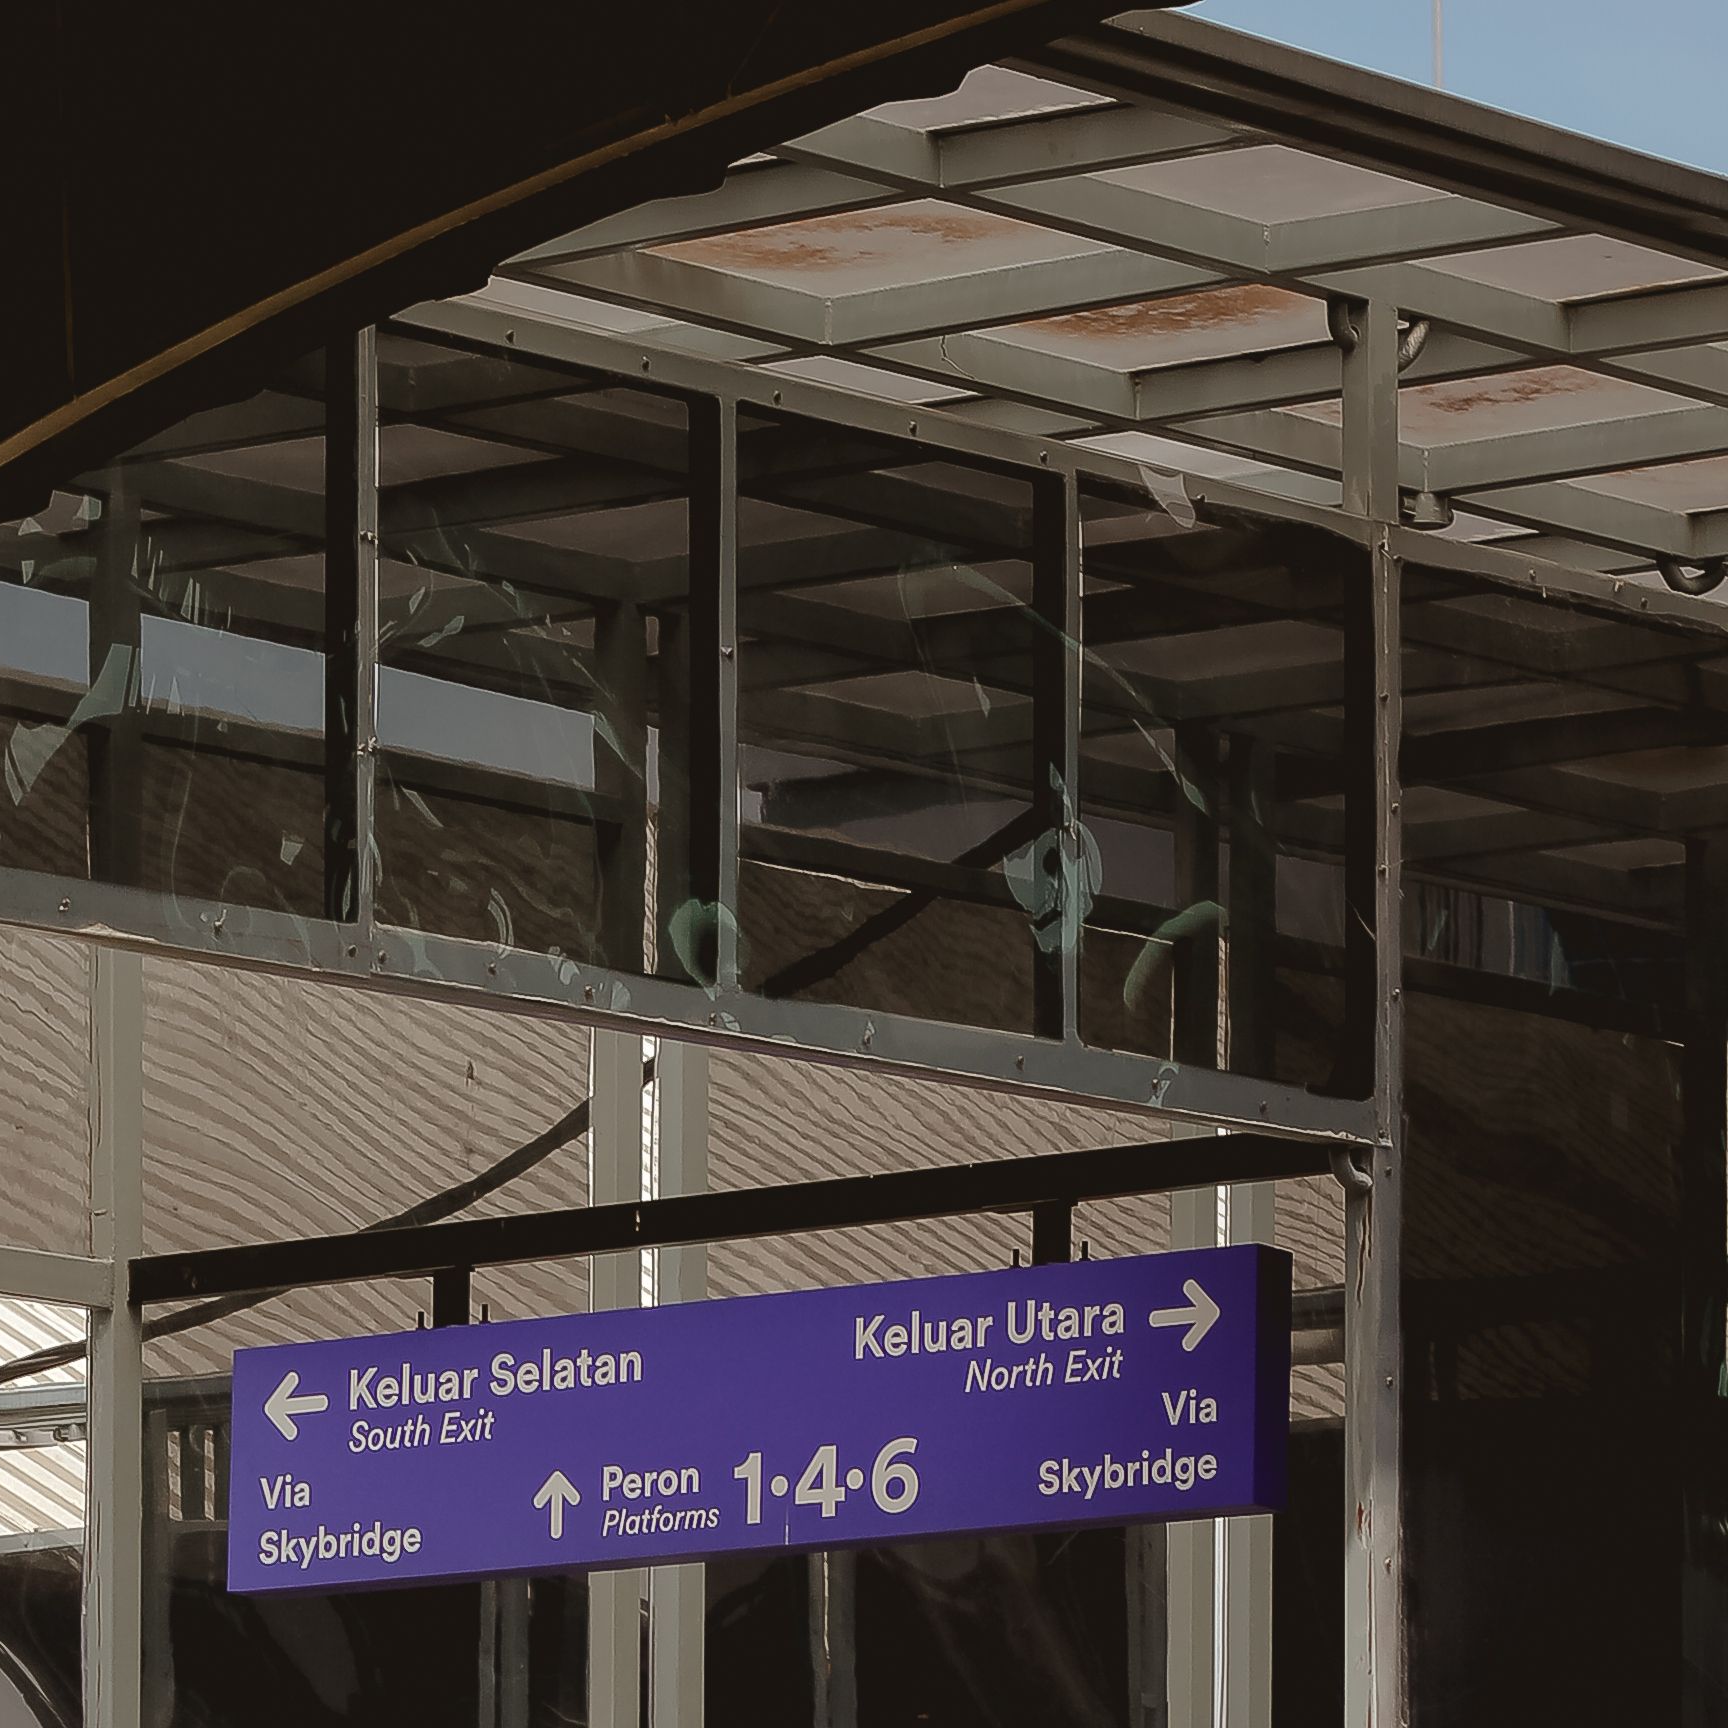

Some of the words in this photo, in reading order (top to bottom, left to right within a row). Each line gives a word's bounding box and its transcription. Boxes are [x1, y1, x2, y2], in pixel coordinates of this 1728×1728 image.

[855, 1309, 993, 1360] Keluar
[1007, 1299, 1125, 1344] Utara
[348, 1362, 479, 1411] Keluar
[489, 1348, 643, 1396] Selatan
[964, 1353, 1054, 1394] North
[1064, 1346, 1124, 1384] Exit
[1162, 1388, 1218, 1426] Via
[348, 1414, 431, 1453] South
[439, 1408, 495, 1445] Exit
[259, 1474, 312, 1510] Via
[602, 1465, 700, 1502] Peron
[1038, 1448, 1218, 1500] Skybridge
[601, 1504, 721, 1538] Platforms
[258, 1521, 423, 1570] Skybridge
